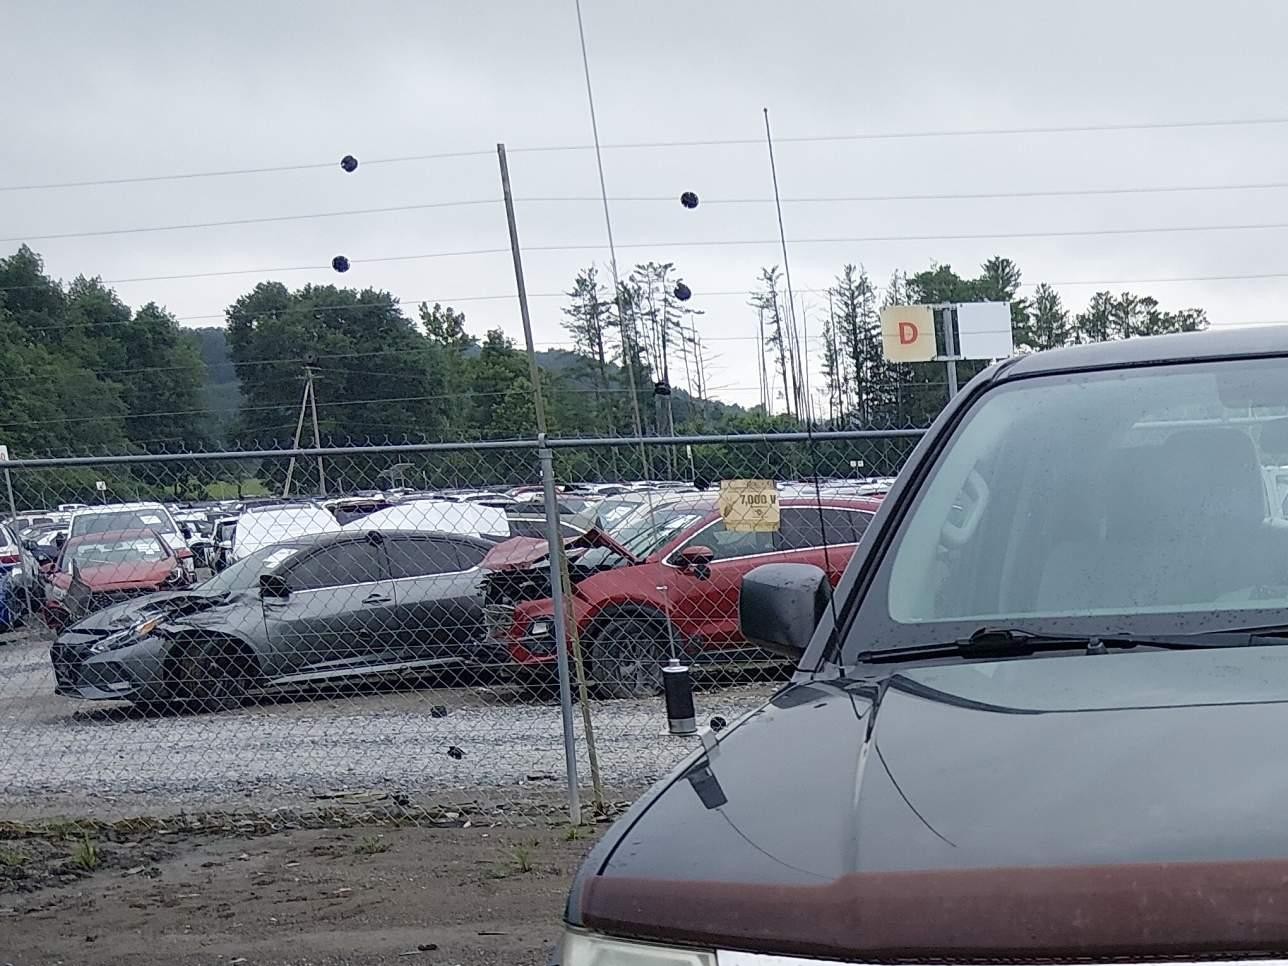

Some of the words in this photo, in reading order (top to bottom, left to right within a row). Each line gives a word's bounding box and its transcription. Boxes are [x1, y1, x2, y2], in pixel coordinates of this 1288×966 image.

[898, 322, 918, 345] D
[740, 494, 767, 507] 7,000
[770, 494, 777, 504] V
